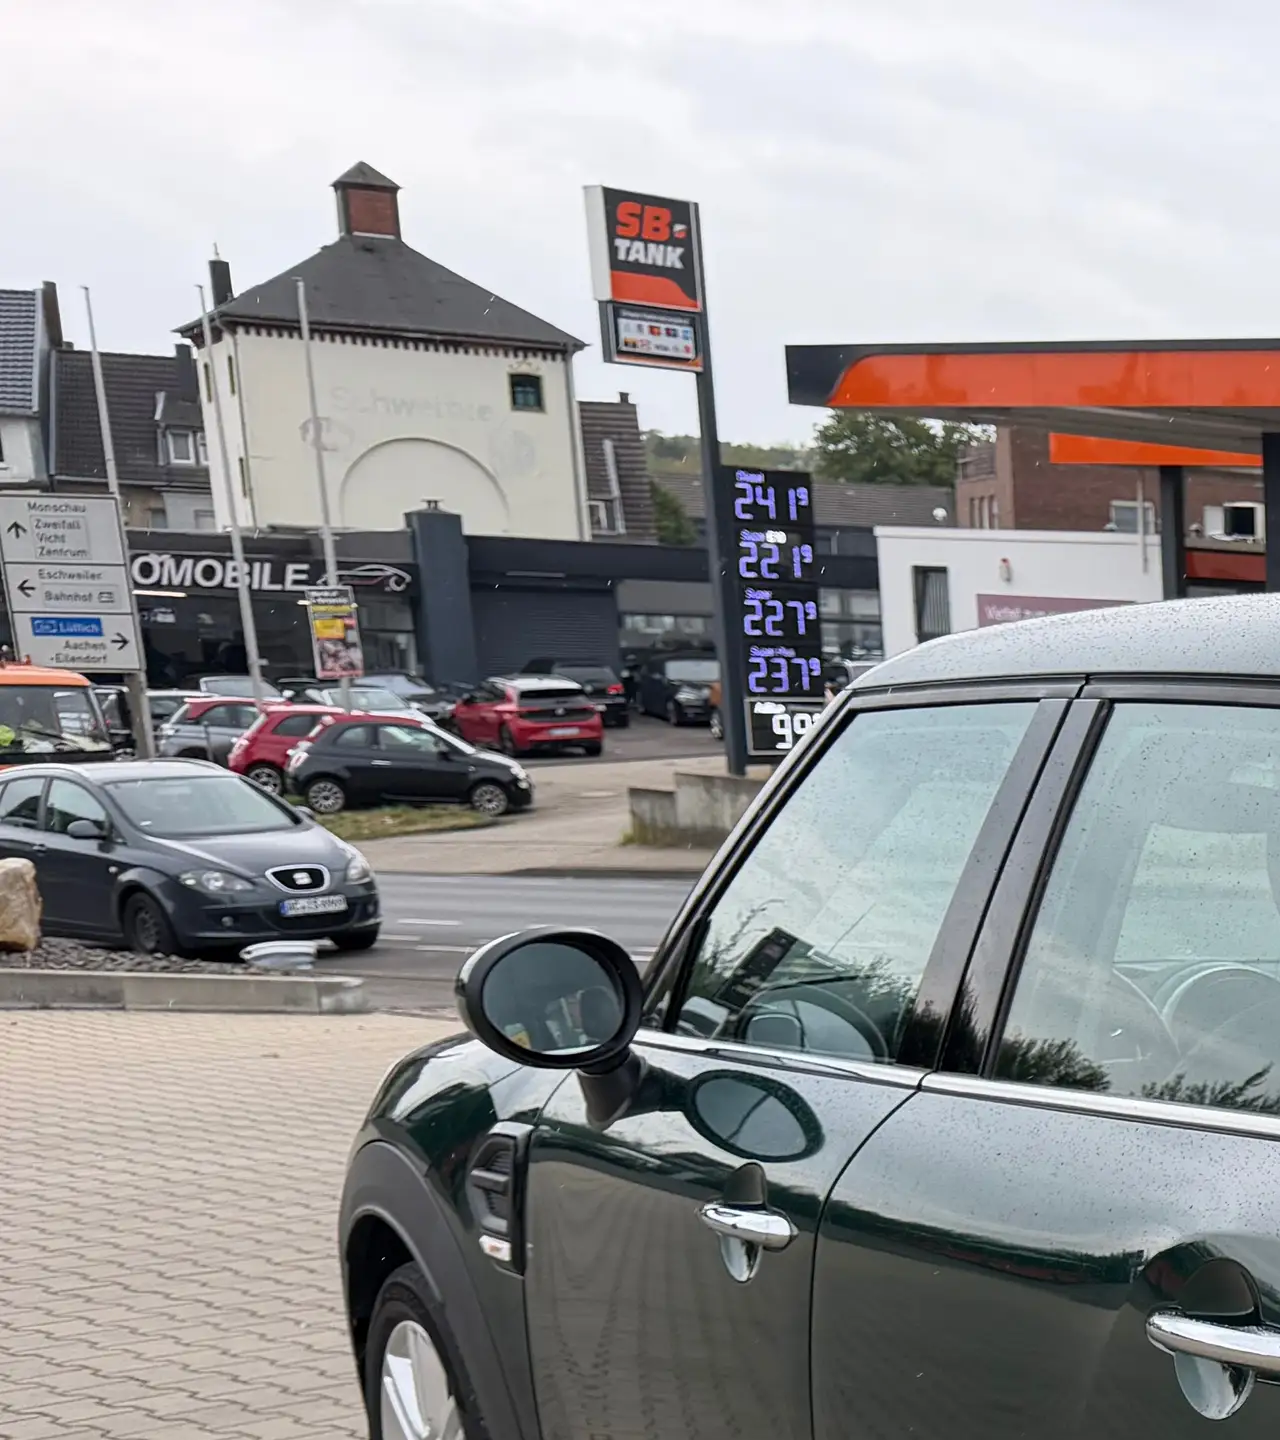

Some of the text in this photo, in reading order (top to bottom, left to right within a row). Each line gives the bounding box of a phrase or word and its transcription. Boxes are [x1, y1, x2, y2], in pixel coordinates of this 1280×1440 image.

[614, 238, 685, 270] TANK
[27, 502, 87, 513] Monschau
[35, 519, 82, 530] Zweifall
[38, 546, 88, 558] Zentrum
[38, 569, 103, 580] Eschweiler
[45, 591, 92, 602] Bahnhof
[63, 640, 107, 651] Aachen
